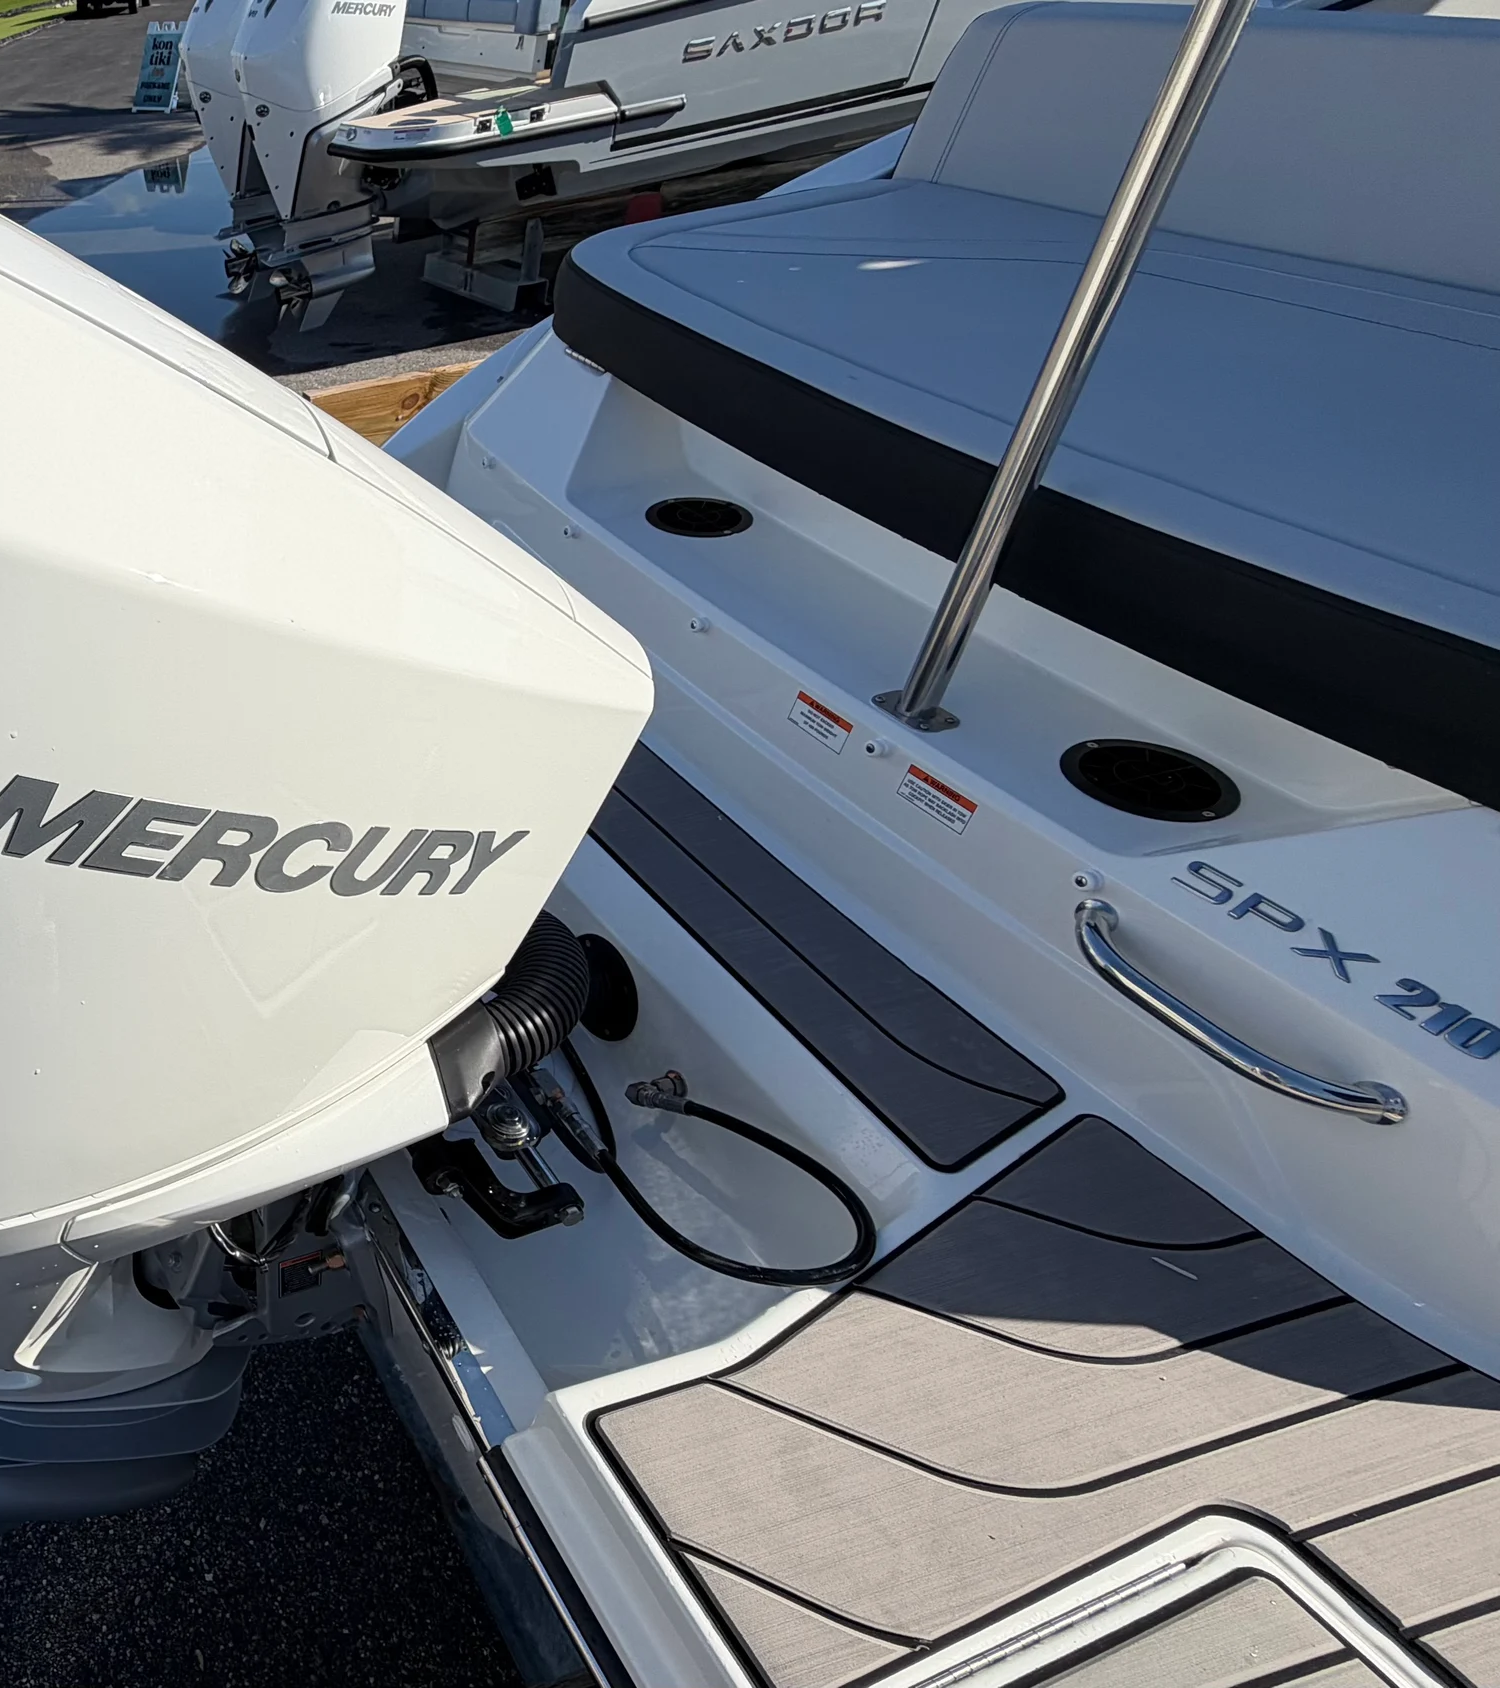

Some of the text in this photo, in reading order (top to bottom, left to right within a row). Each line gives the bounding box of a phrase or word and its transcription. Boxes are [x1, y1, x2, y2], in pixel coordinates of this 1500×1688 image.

[331, 1, 397, 17] MERCURY
[682, 0, 887, 64] SAXDOR
[152, 37, 173, 50] kon
[149, 51, 173, 66] tiki
[930, 778, 961, 802] WARNING
[1171, 861, 1500, 1060] SPX 210
